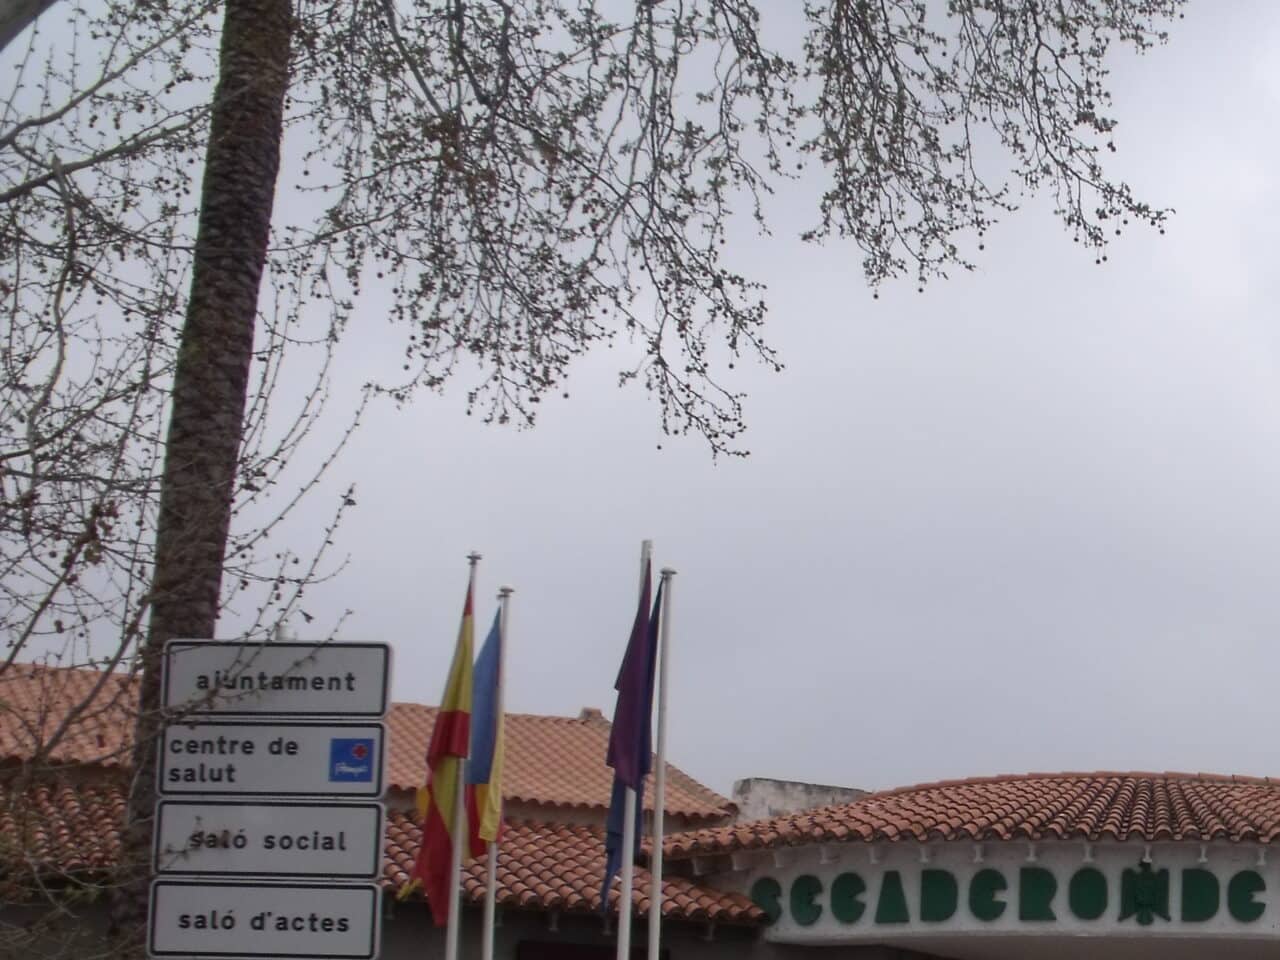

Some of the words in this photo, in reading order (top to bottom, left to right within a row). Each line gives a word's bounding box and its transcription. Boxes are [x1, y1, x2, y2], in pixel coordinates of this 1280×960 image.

[196, 671, 356, 694] ajuntament
[169, 736, 255, 756] centre
[268, 735, 298, 756] de
[168, 763, 236, 783] salut
[188, 828, 248, 850] saló
[263, 830, 346, 852] social
[178, 909, 236, 931] saló
[250, 911, 350, 933] d'actes
